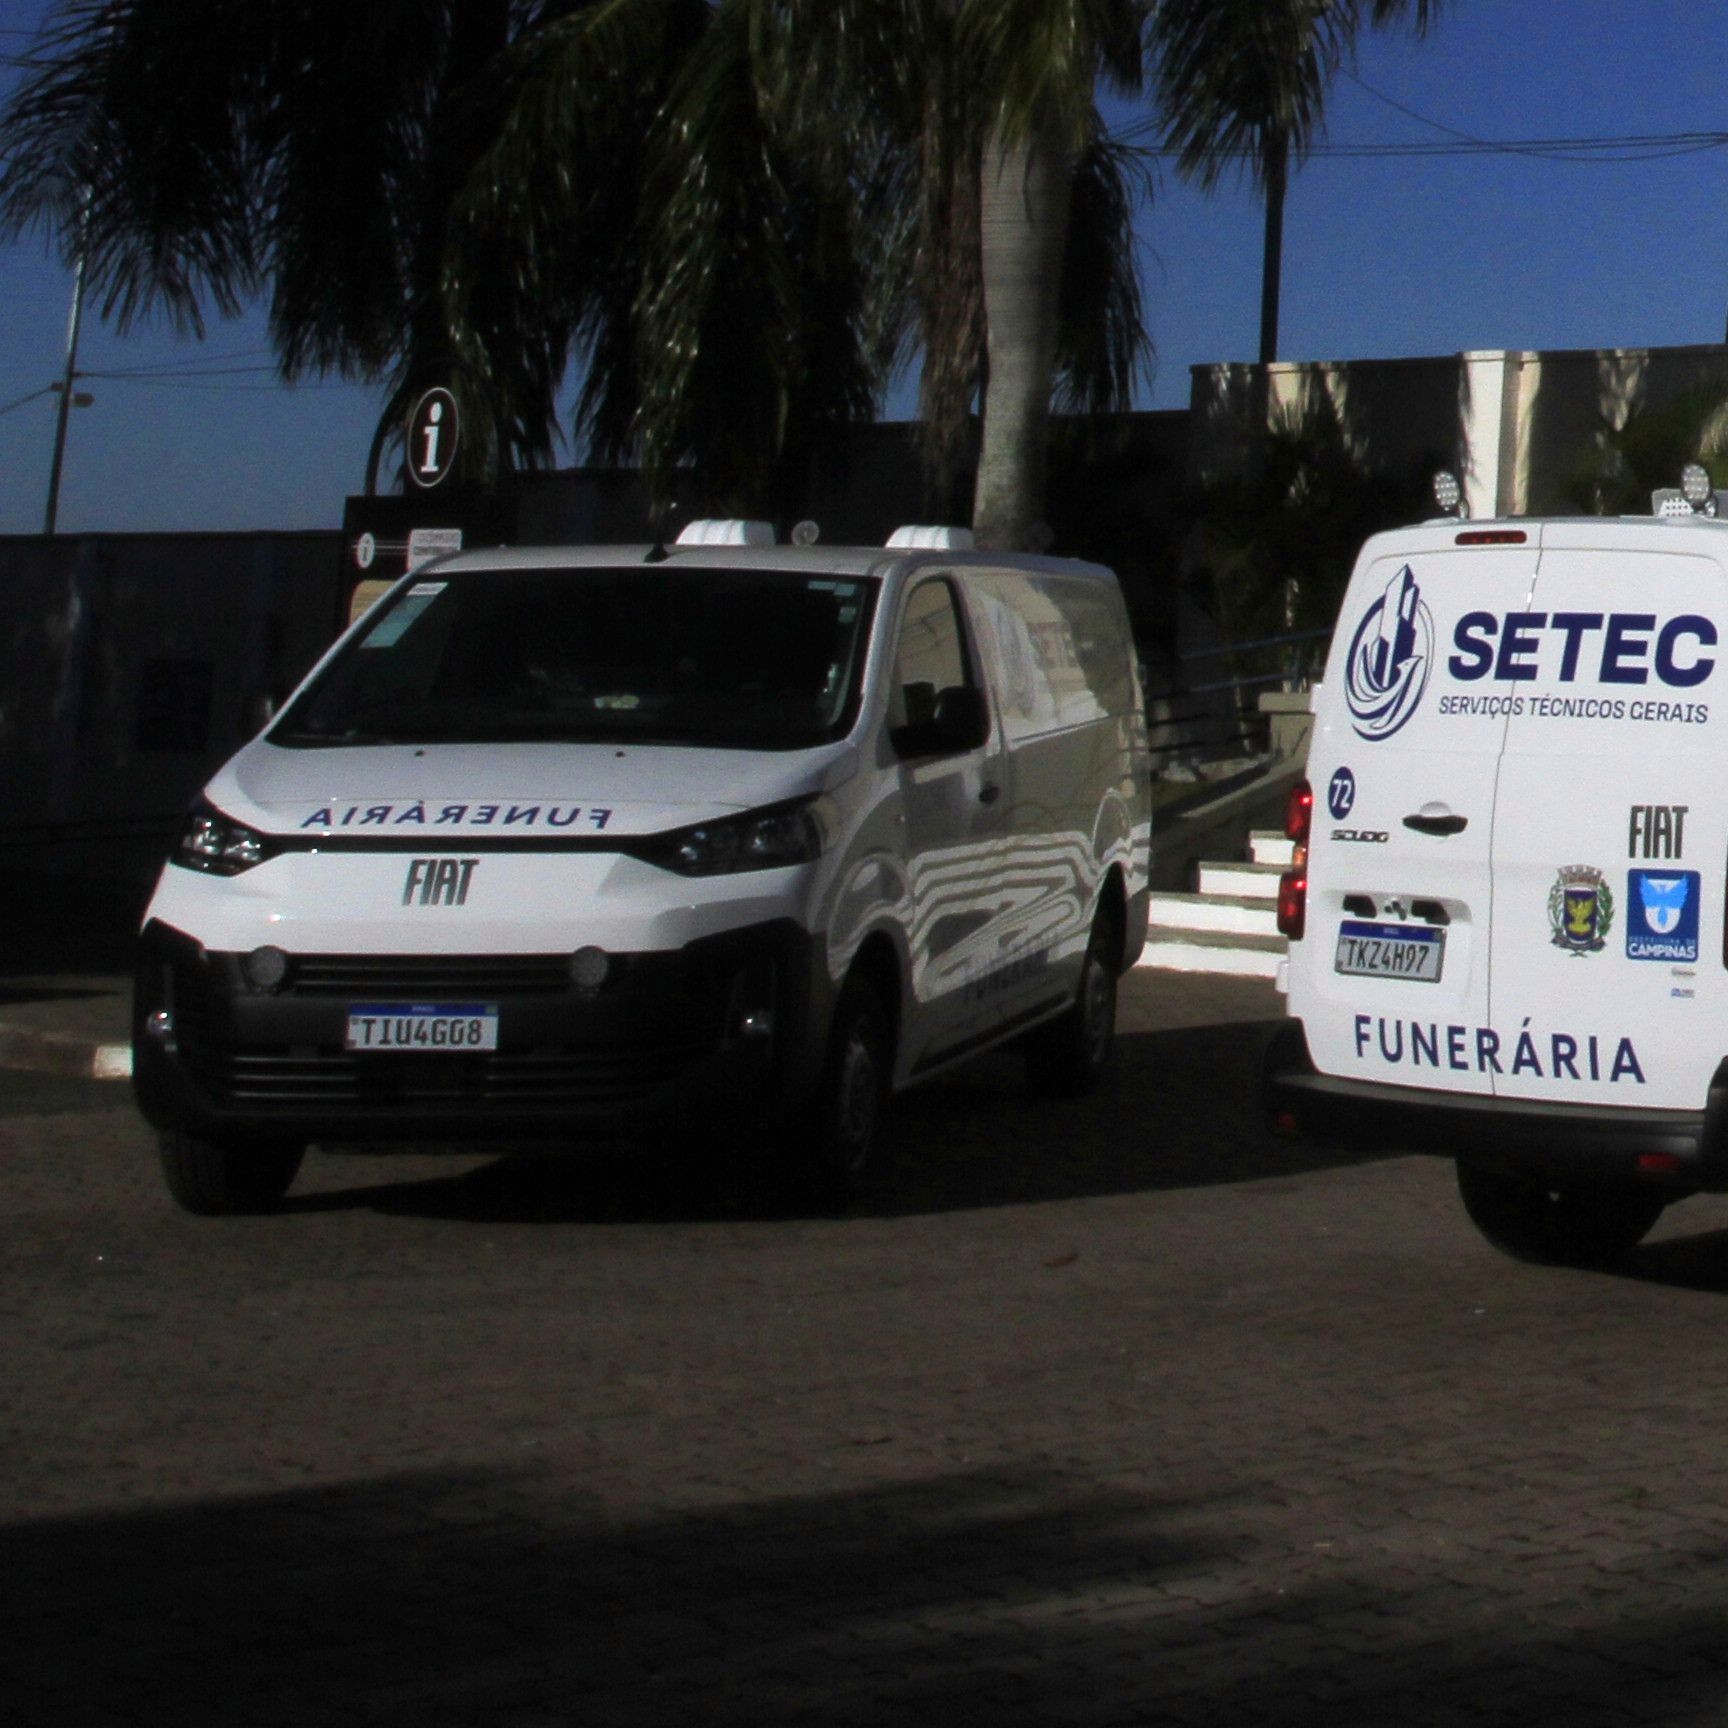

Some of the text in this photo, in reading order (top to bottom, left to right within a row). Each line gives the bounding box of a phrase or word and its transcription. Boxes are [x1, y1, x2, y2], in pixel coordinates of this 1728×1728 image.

[1448, 611, 1718, 688] SETEC
[1438, 693, 1709, 724] SERVIÇOS TÉCNICOS GERAIS
[1331, 778, 1351, 809] 72
[1628, 804, 1689, 859] FIAT
[402, 859, 480, 907] FIAT
[1345, 939, 1430, 974] TKZ4H97
[1628, 943, 1696, 959] CAMPINAS
[1354, 1014, 1646, 1084] FUNERÁRIA
